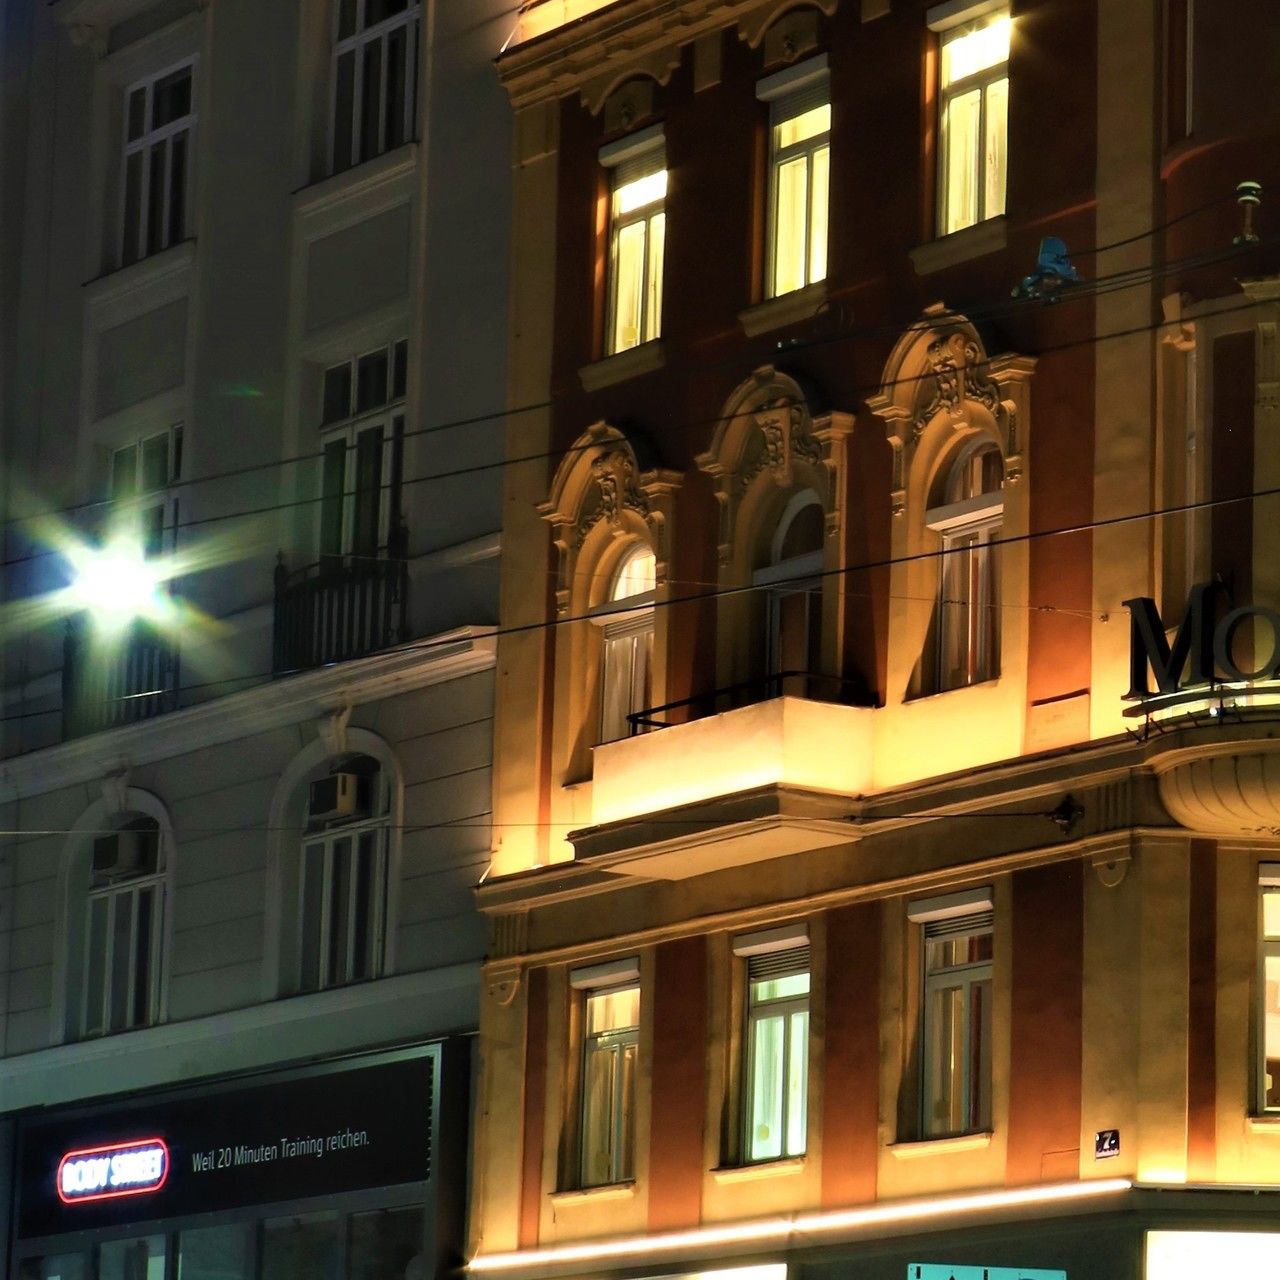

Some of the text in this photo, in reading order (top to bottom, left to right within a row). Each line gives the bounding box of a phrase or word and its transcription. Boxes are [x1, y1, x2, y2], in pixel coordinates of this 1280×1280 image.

[192, 1127, 370, 1172] Weil 20 Minuten Training reichen.
